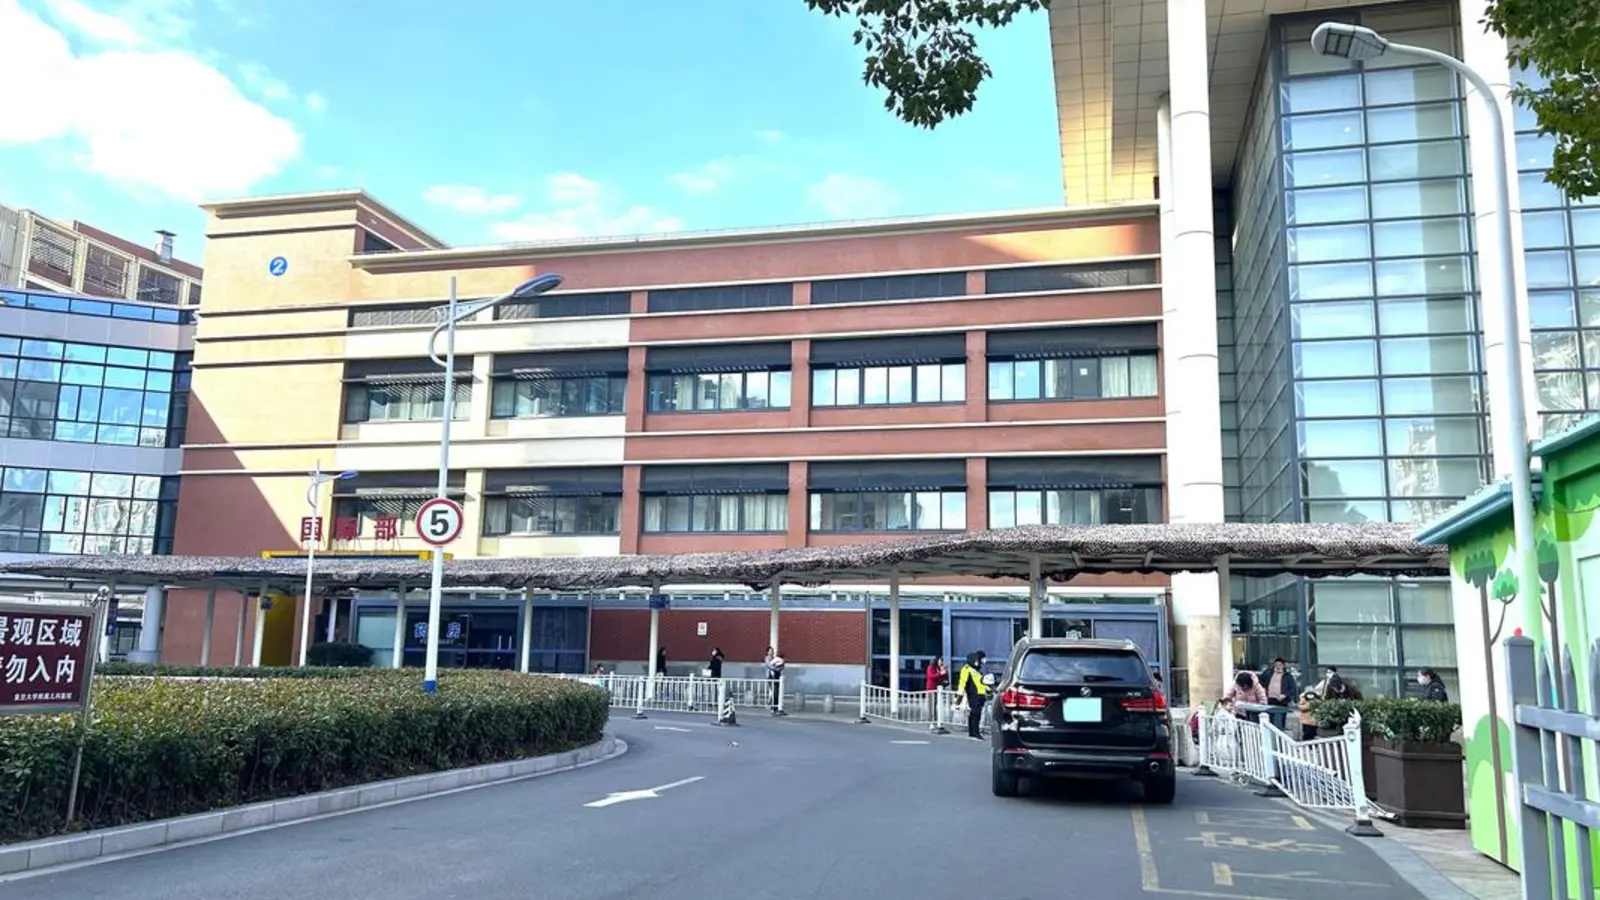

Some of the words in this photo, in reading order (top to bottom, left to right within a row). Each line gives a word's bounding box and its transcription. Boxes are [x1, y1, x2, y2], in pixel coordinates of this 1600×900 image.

[273, 259, 285, 273] 2
[430, 509, 450, 536] 5
[0, 654, 77, 684] 勿入内
